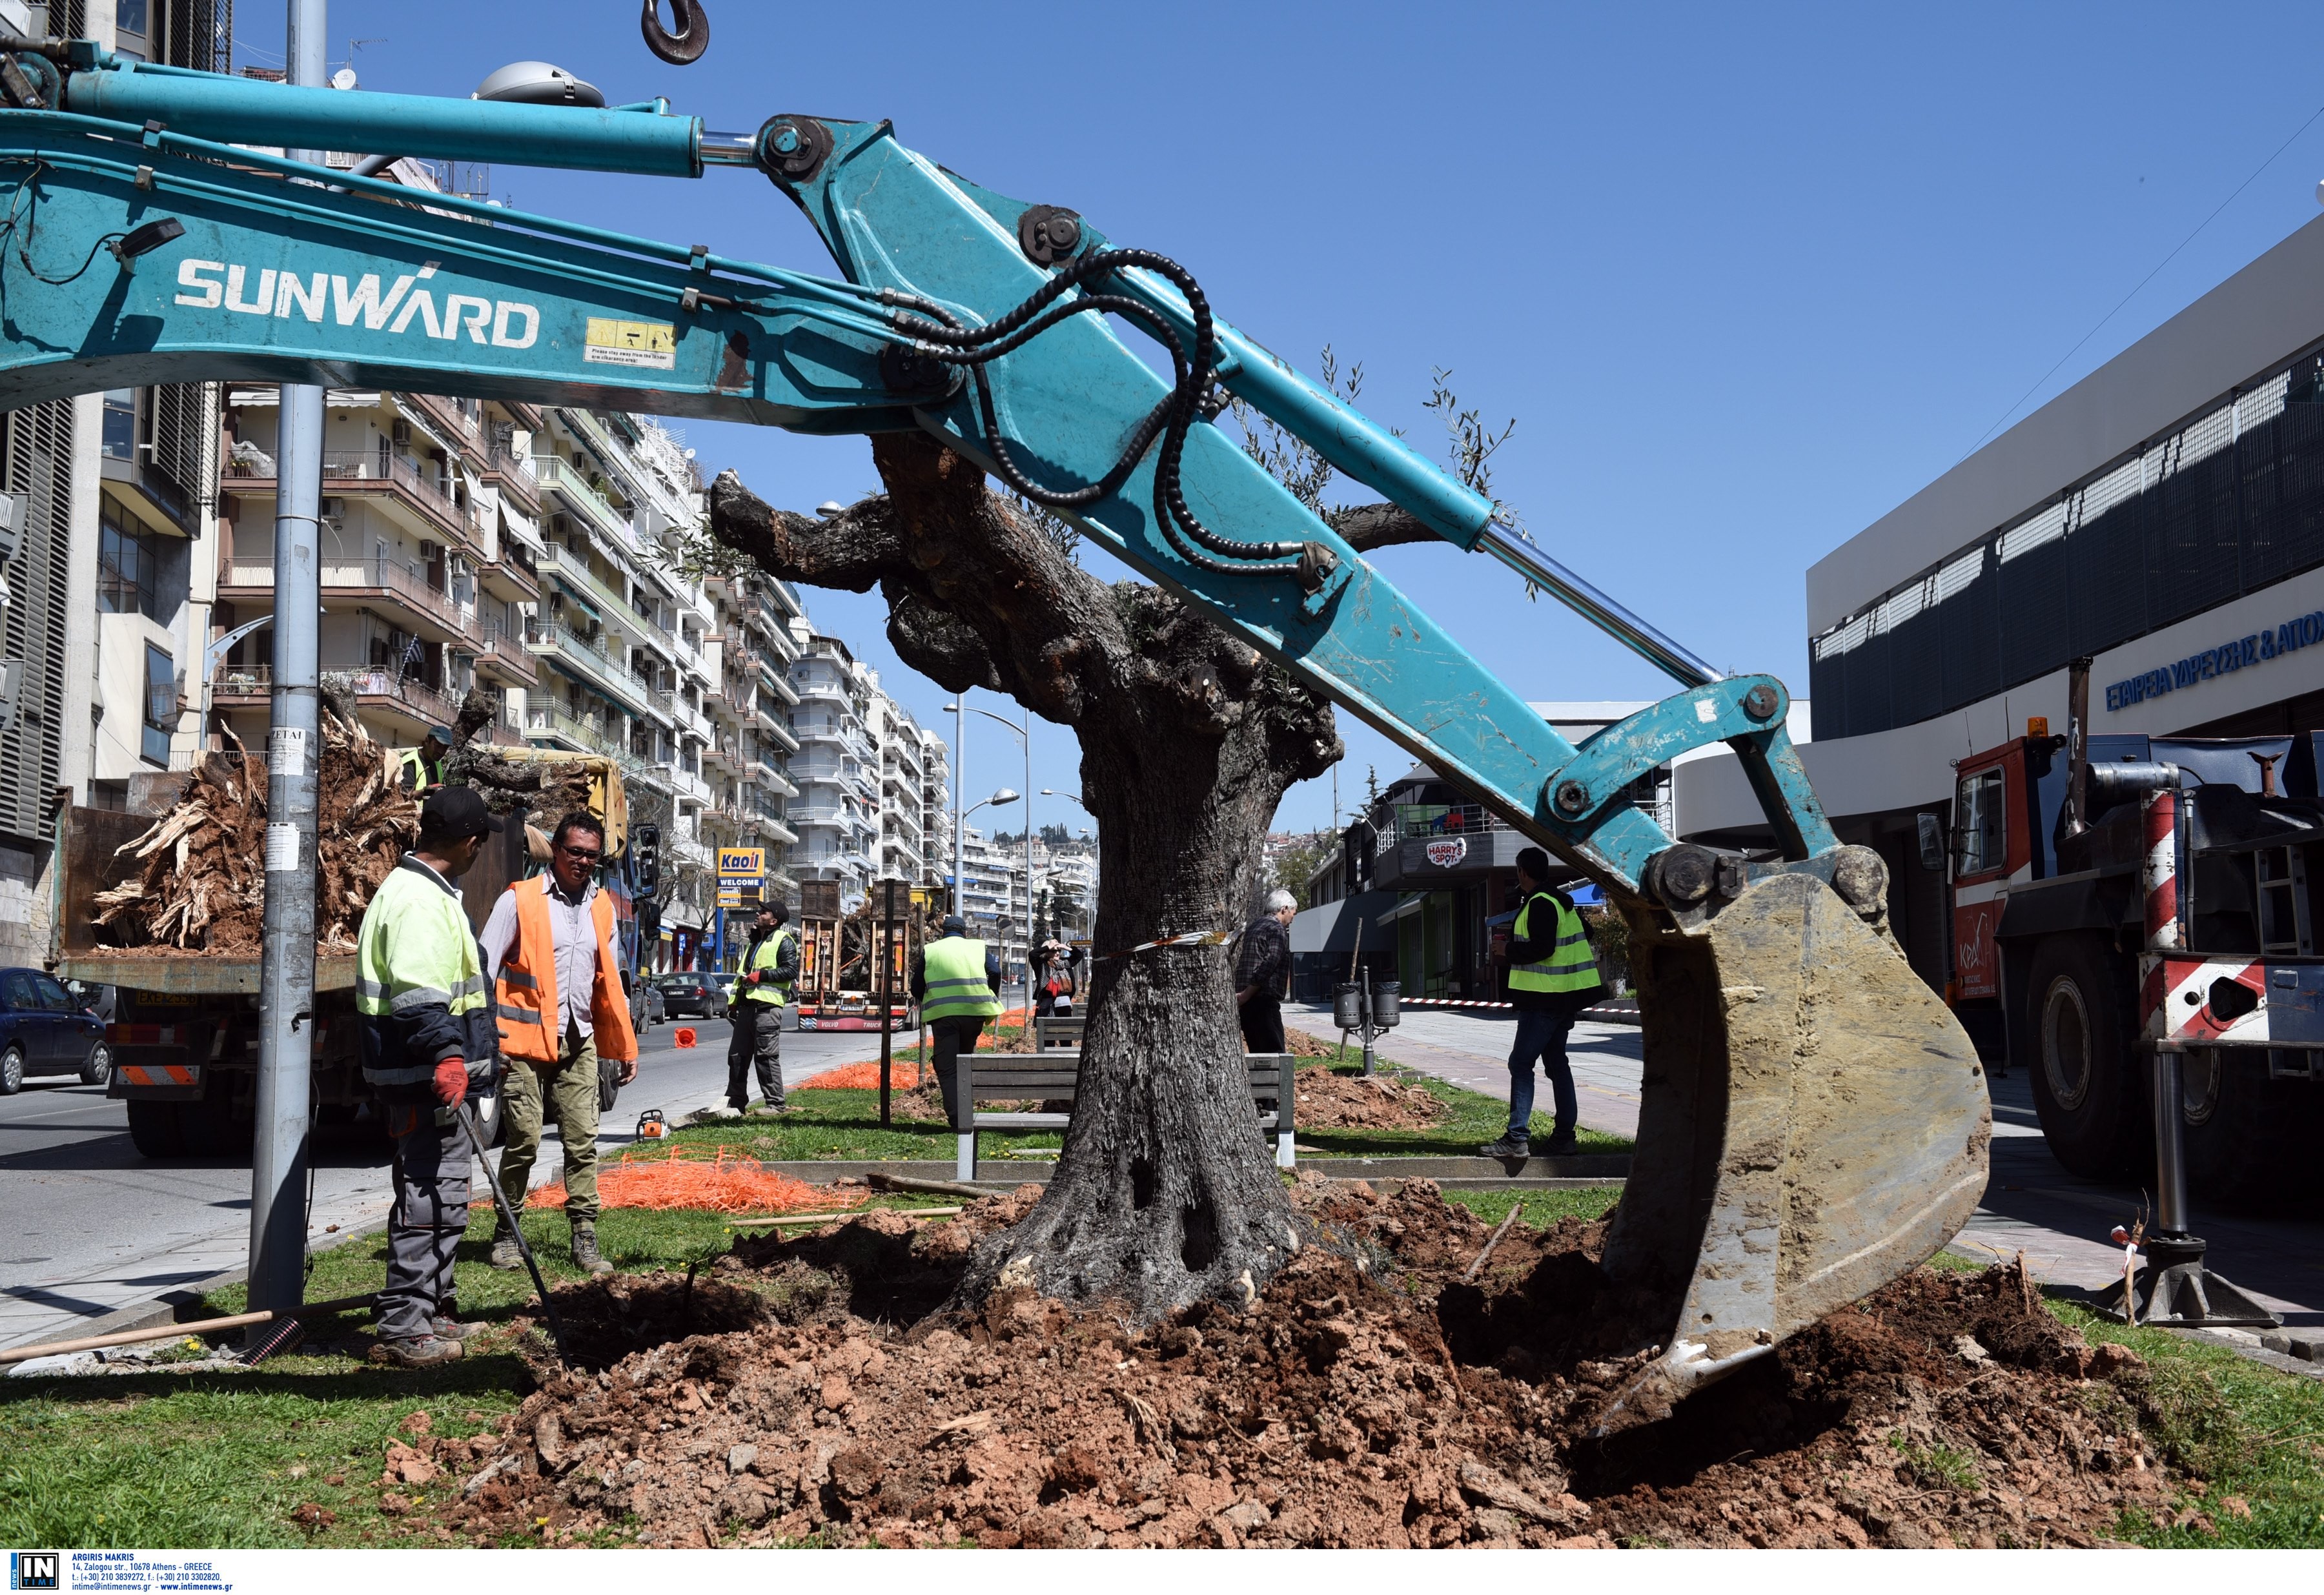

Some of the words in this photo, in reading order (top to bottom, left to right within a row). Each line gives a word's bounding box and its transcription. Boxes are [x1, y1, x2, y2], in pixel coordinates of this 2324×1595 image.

[2106, 667, 2172, 712] ΕΤΑΙΡΕΙΑ
[2170, 635, 2259, 689] ΥΔΡΕΥΣΗΣ
[2259, 630, 2275, 660] &
[269, 730, 301, 740] ΖΕΤΑΙ
[721, 851, 759, 868] Kaoil
[1435, 854, 1456, 866] SPOT
